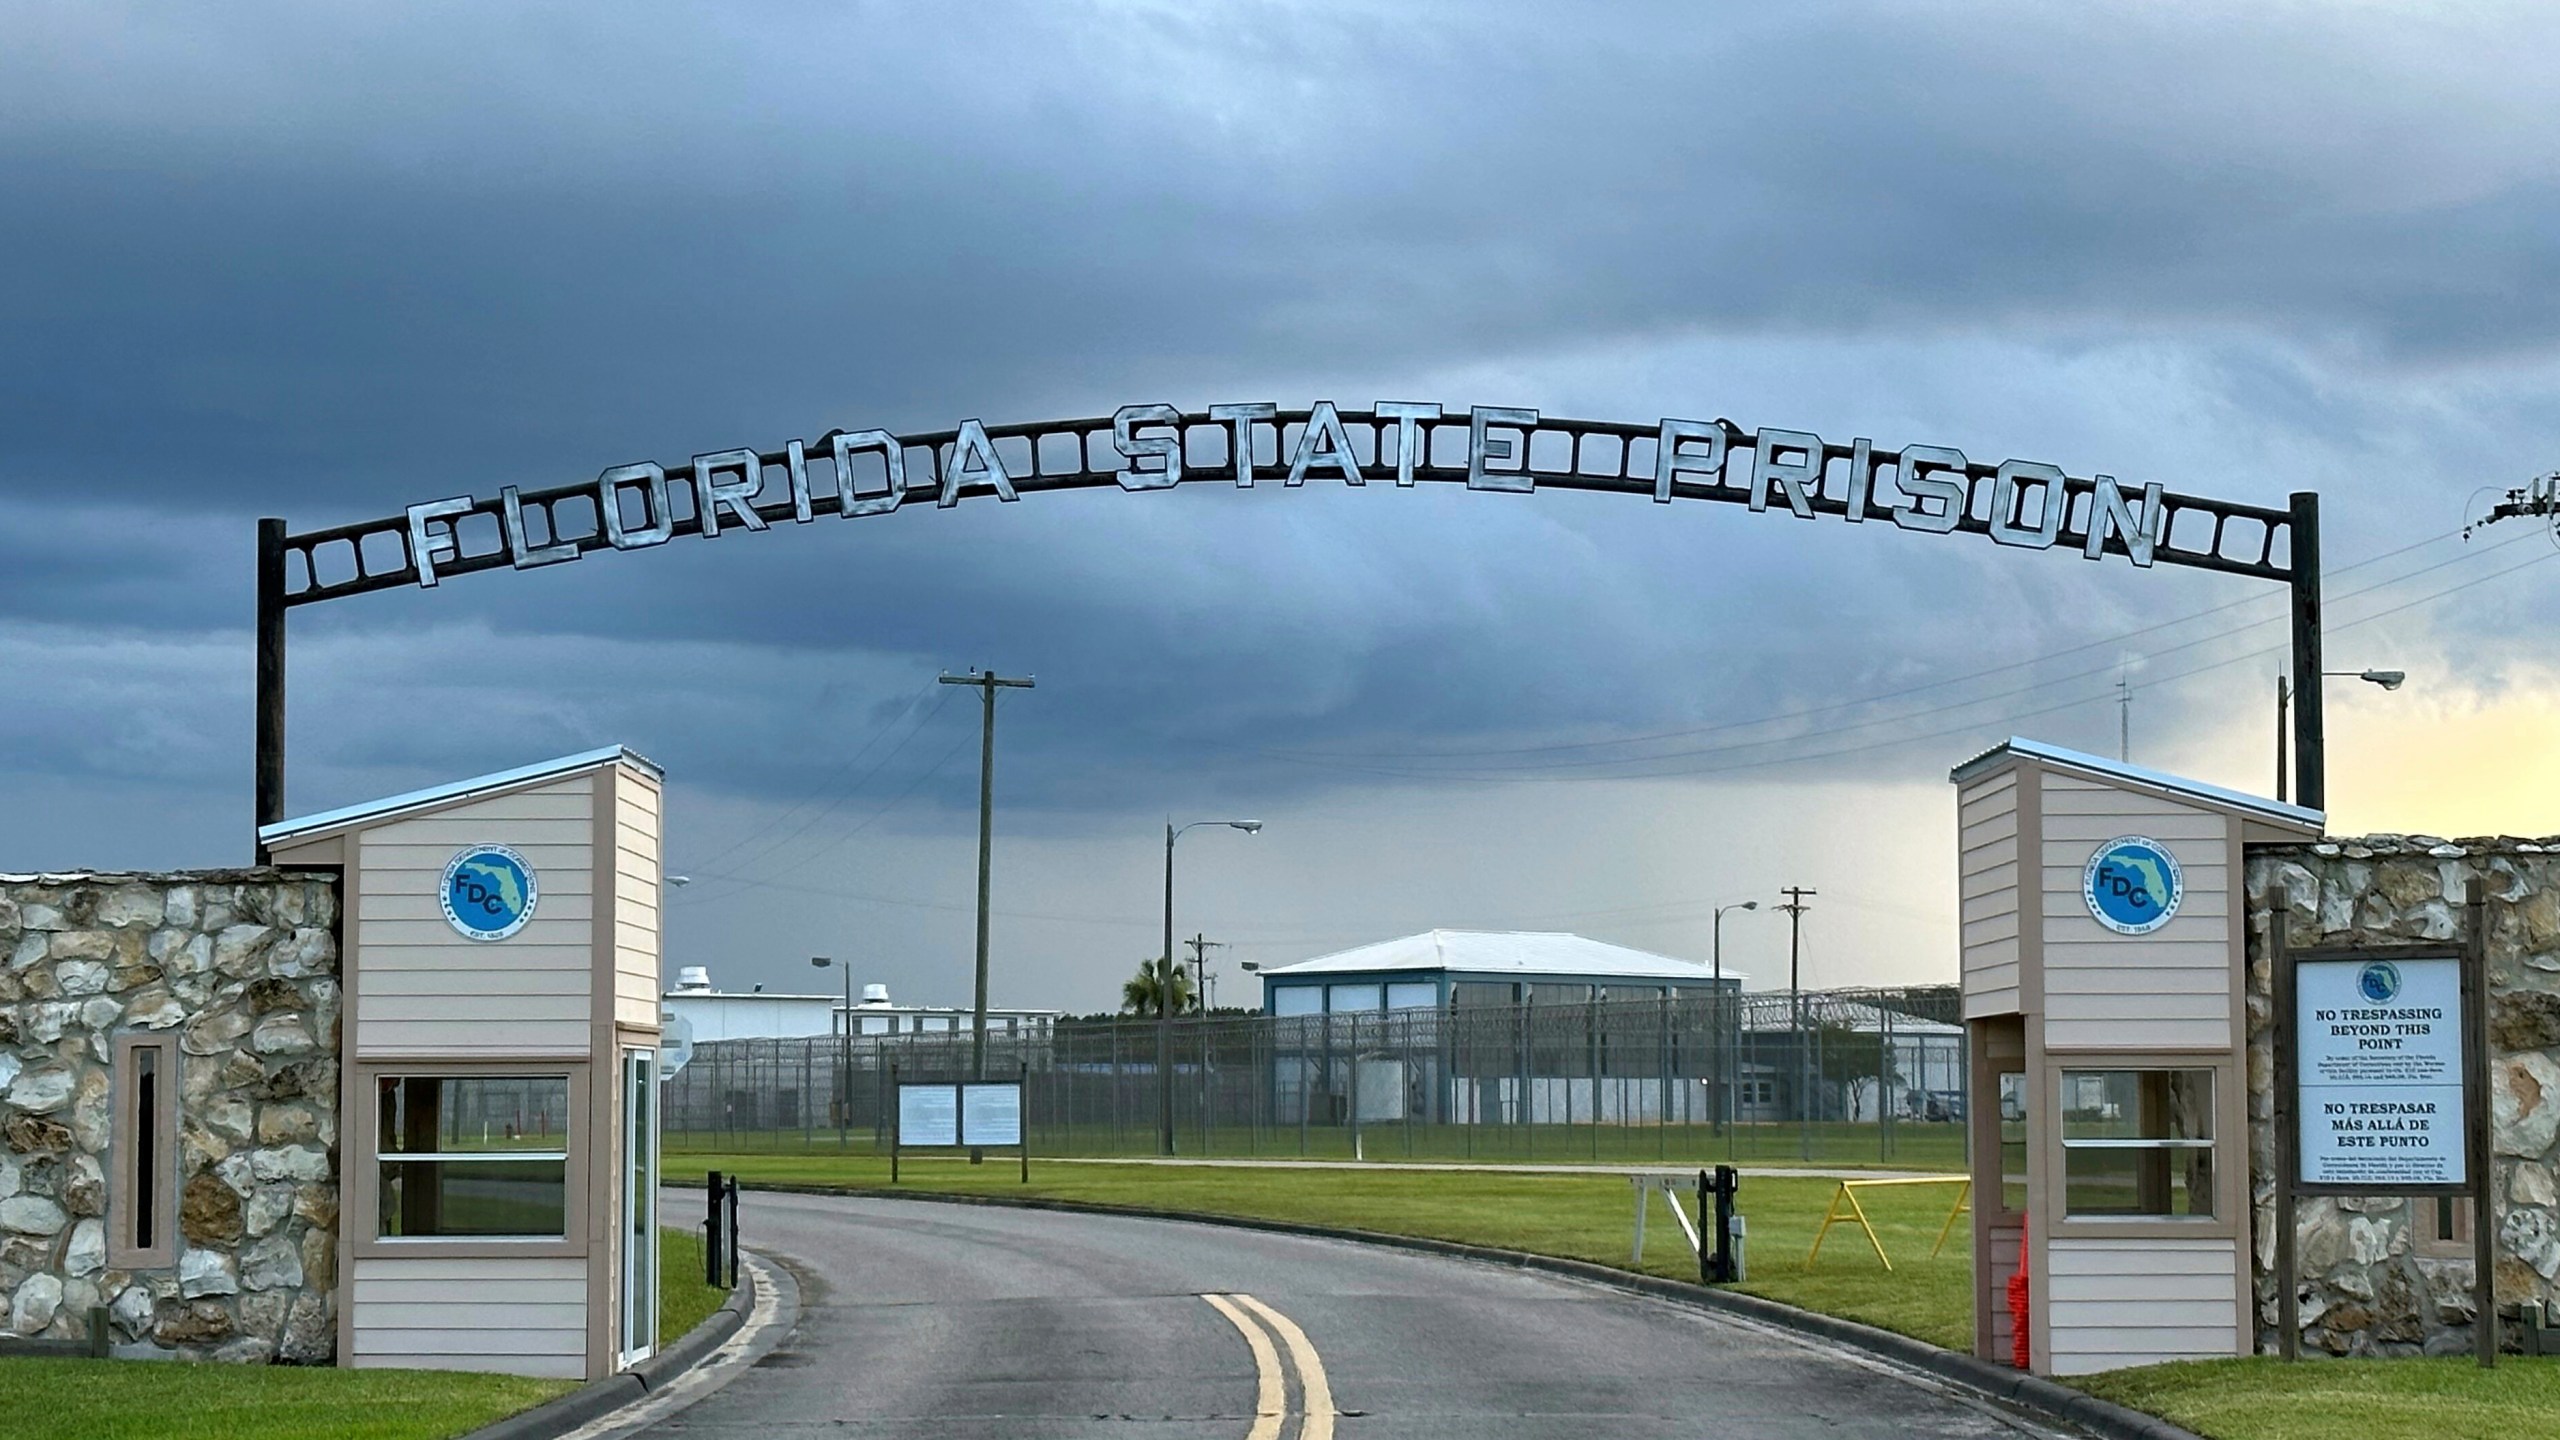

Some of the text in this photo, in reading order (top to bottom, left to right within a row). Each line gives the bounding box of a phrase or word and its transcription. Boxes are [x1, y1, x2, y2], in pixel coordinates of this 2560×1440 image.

[405, 400, 2164, 588] FLORIDA STATE PRISON
[2099, 867, 2149, 908] FDC
[455, 874, 503, 915] FDC
[2316, 1008, 2442, 1021] NO TRESPASSING
[2331, 1024, 2431, 1036] BEYOND THIS
[2359, 1038, 2403, 1050] POINT
[2324, 1103, 2437, 1114] NO TRESPASAR
[2331, 1116, 2430, 1131] MÁS ALLÁ DE
[2337, 1136, 2429, 1147] ESTE PUNTO
